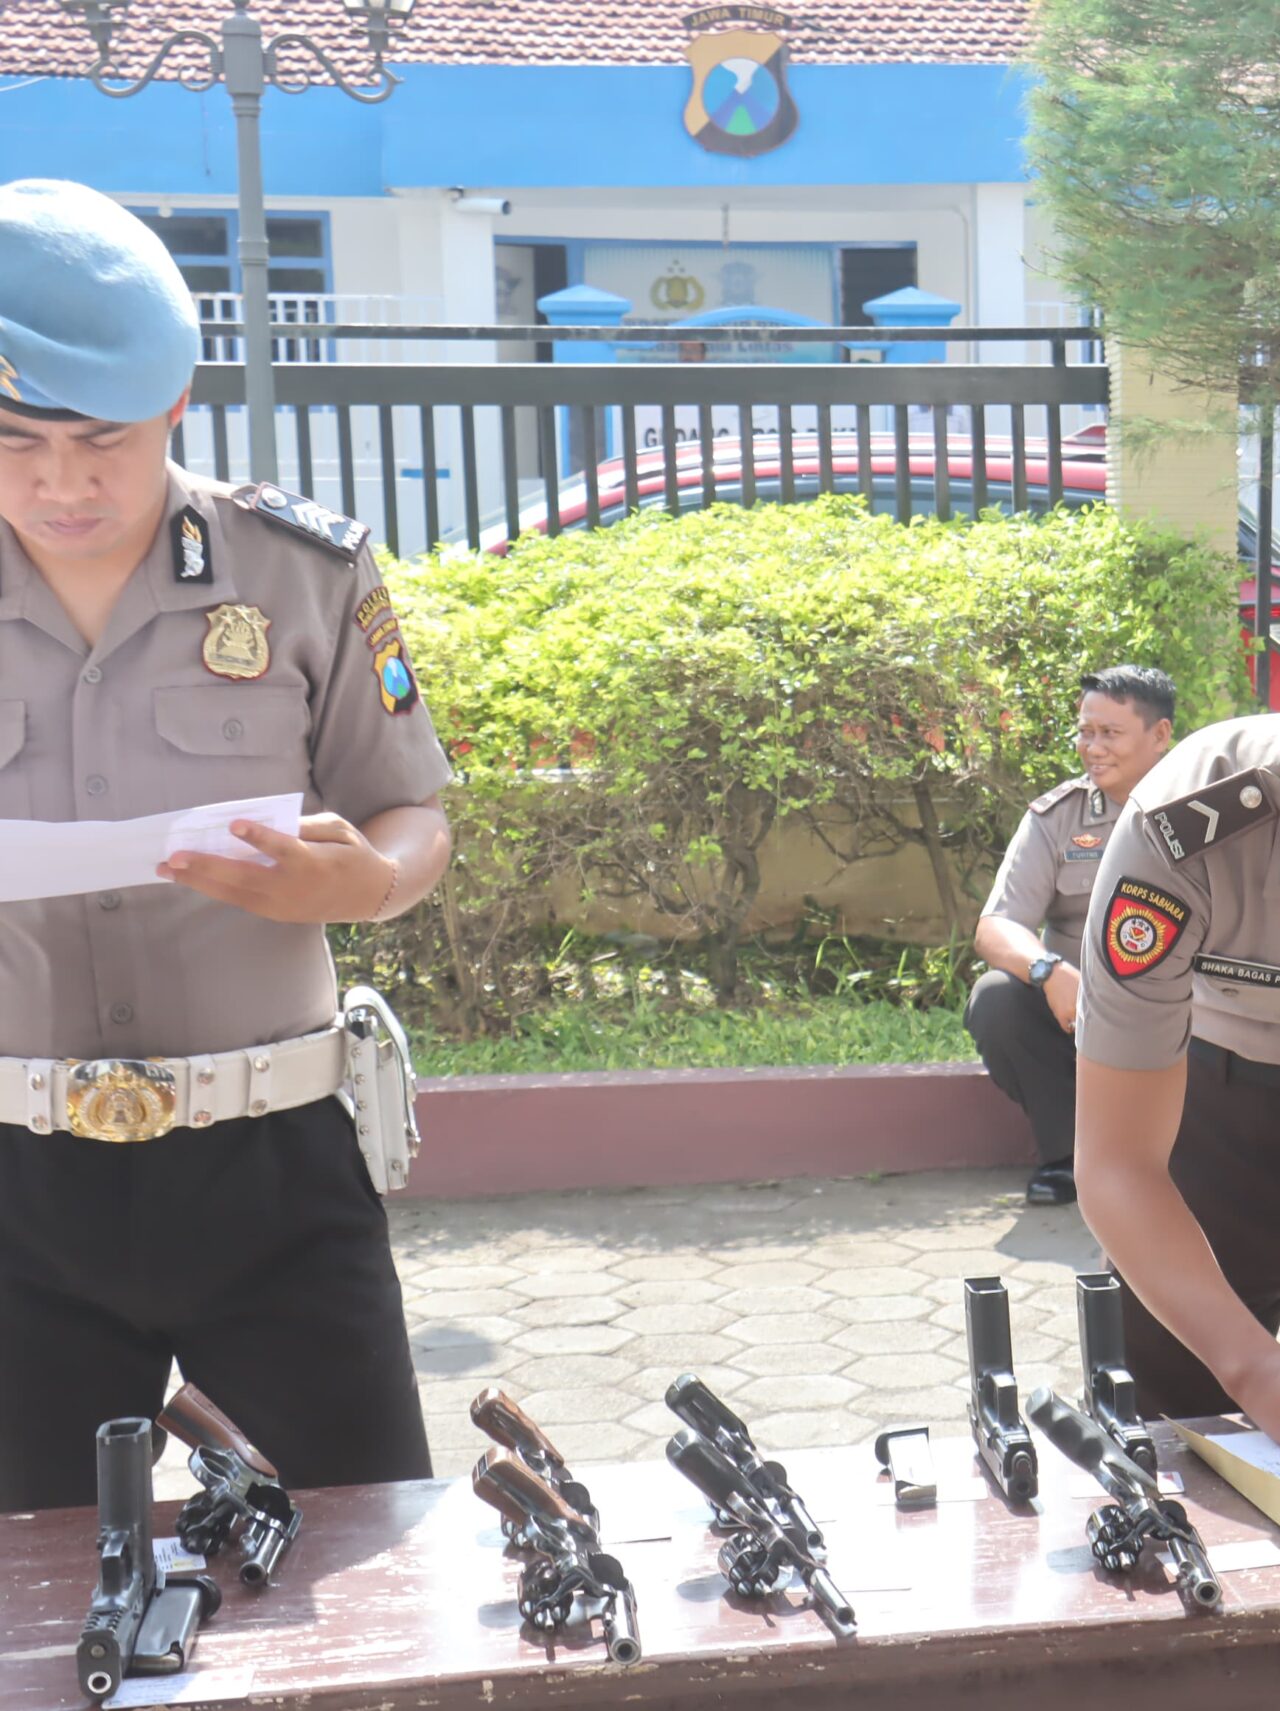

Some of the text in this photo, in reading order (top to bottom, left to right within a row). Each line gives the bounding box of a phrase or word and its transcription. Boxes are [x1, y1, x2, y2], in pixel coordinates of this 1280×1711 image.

[691, 7, 731, 27] JAWA
[1154, 811, 1185, 860] POLISI
[1121, 882, 1185, 922] KORPS SABHARA
[1201, 961, 1234, 975] SHAKA
[1237, 968, 1272, 982] BAGAS
